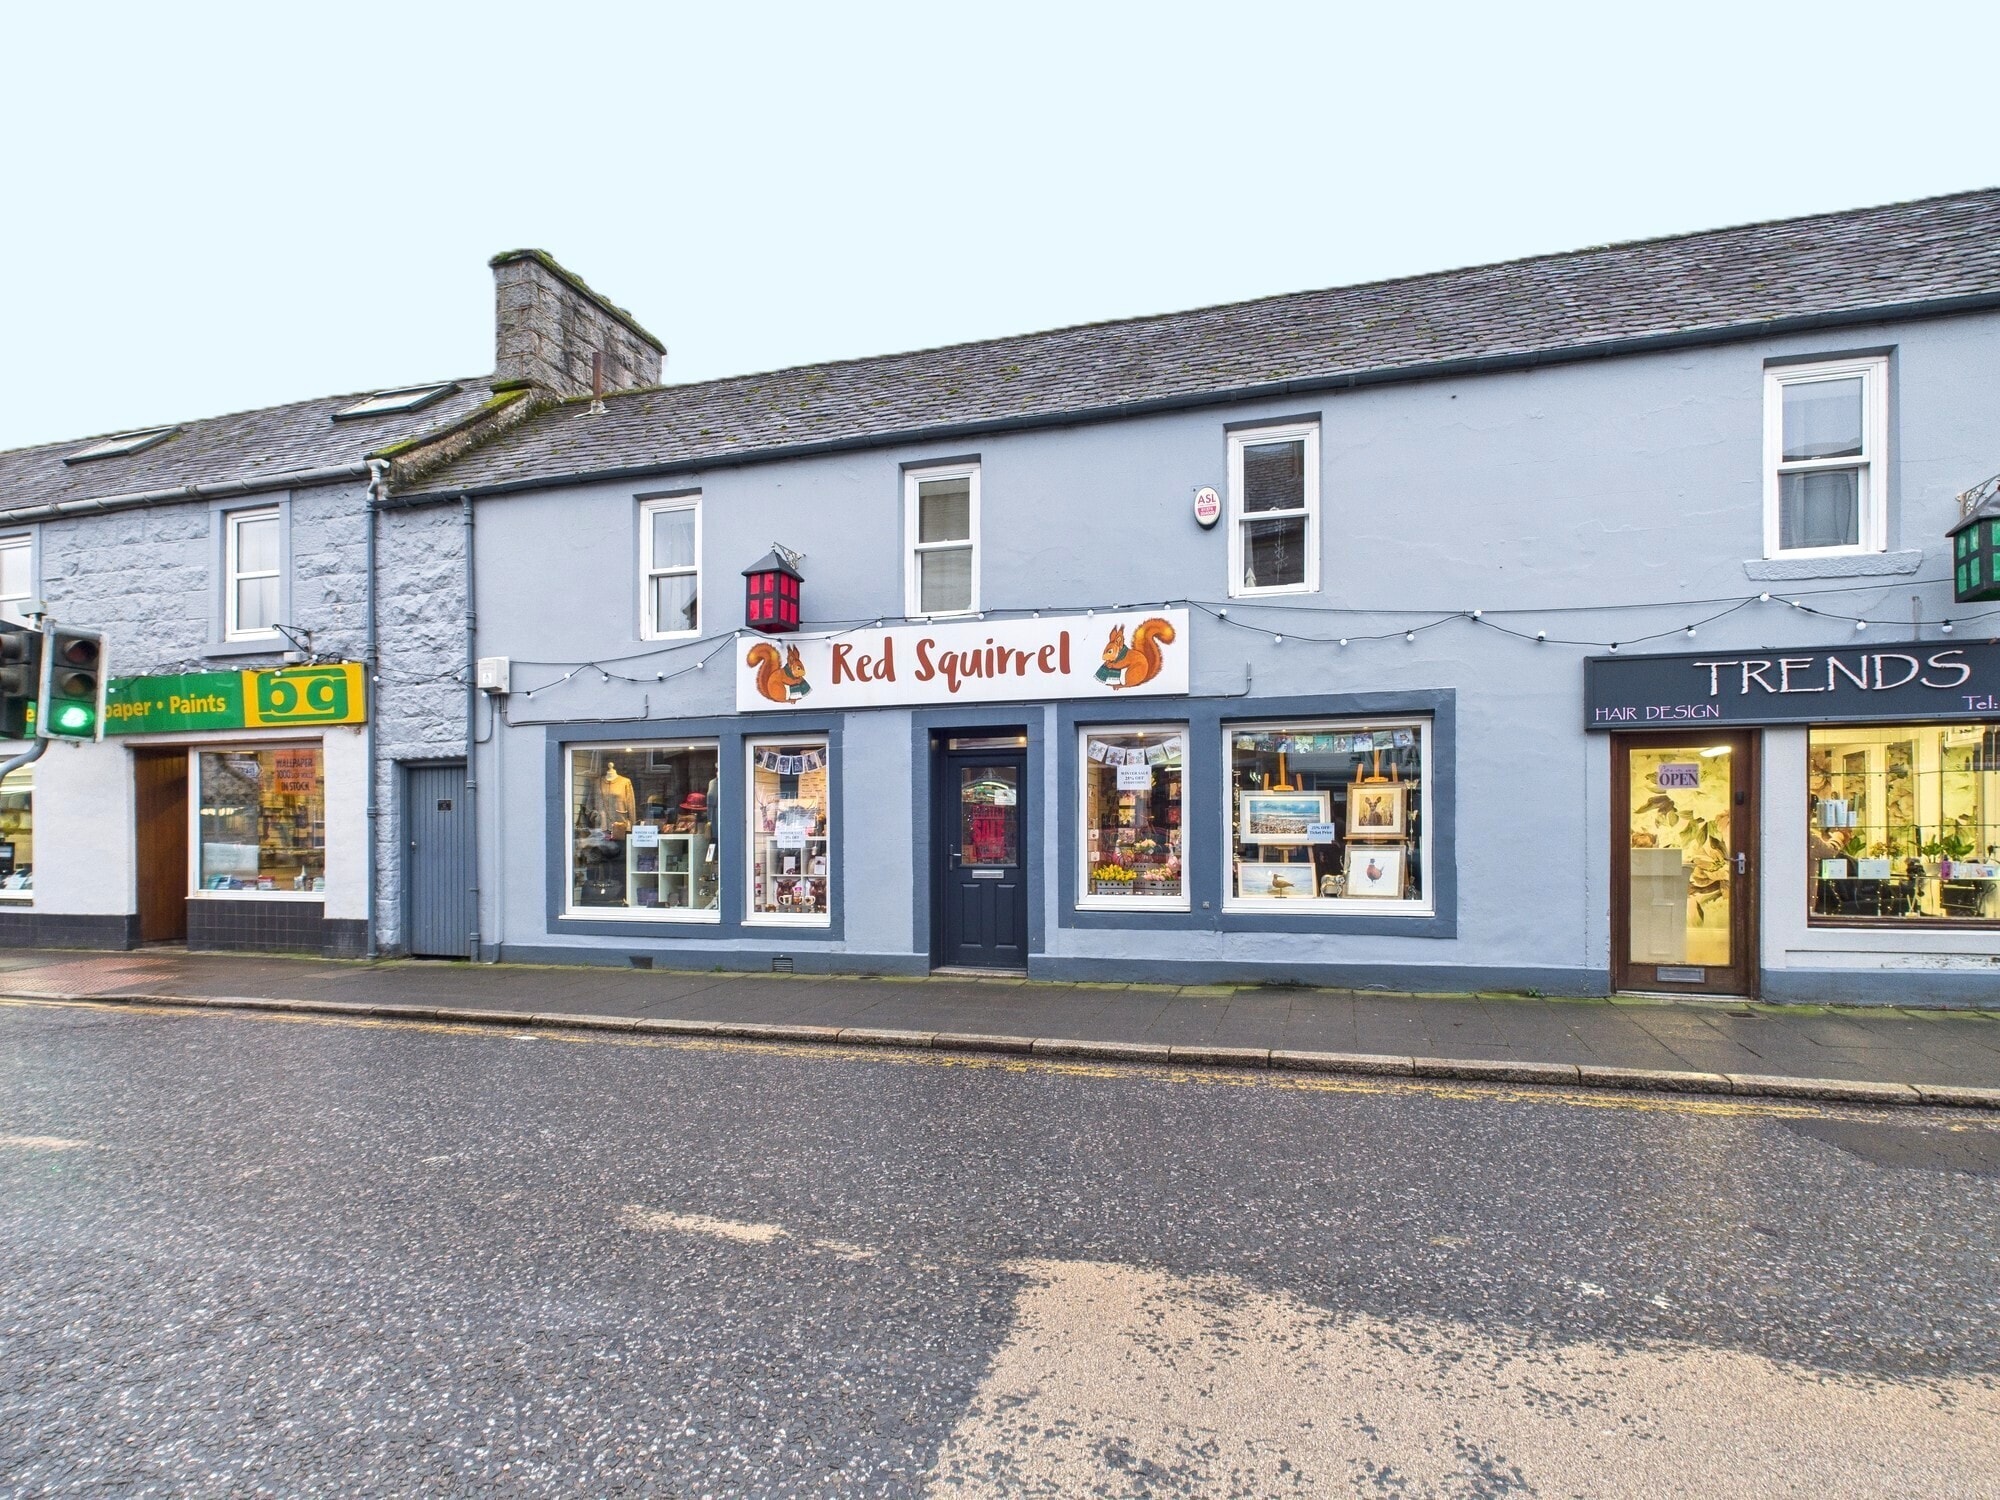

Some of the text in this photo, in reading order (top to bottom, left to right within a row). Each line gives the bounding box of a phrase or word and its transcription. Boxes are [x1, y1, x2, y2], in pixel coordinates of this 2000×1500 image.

[1197, 493, 1216, 504] ASL
[831, 630, 1072, 693] Red Squirrel
[1693, 650, 1971, 696] TRENDS
[257, 670, 348, 721] bg
[1961, 694, 1999, 711] Tel:
[104, 693, 226, 721] paper Paints
[1595, 703, 1720, 721] HAIR DESIGN
[276, 758, 313, 768] WALLPAPER
[281, 781, 310, 791] IN STOCK
[1659, 773, 1698, 786] OPEN
[973, 819, 1004, 840] SALE
